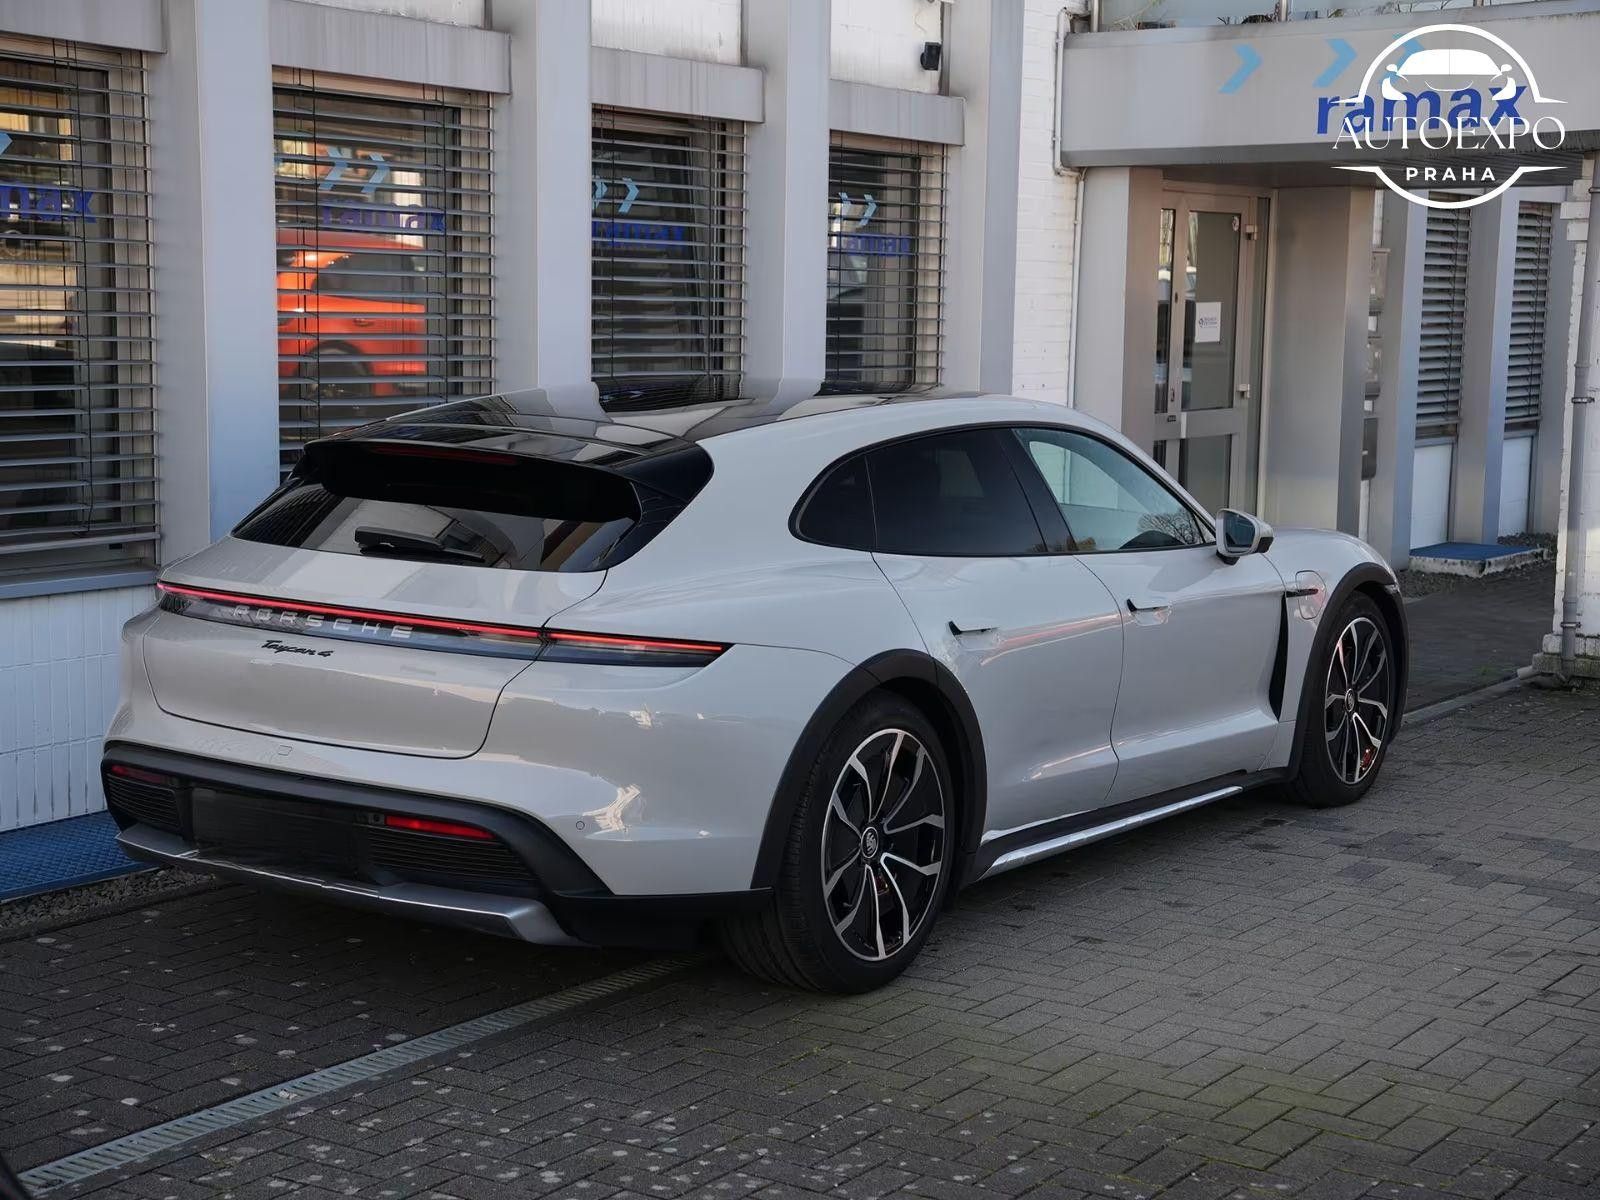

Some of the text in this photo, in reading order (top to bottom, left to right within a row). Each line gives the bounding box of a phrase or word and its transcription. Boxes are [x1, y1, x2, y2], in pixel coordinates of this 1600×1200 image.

[1316, 85, 1527, 135] ramax
[233, 604, 413, 639] PORSCHE
[261, 639, 317, 656] Taycan
